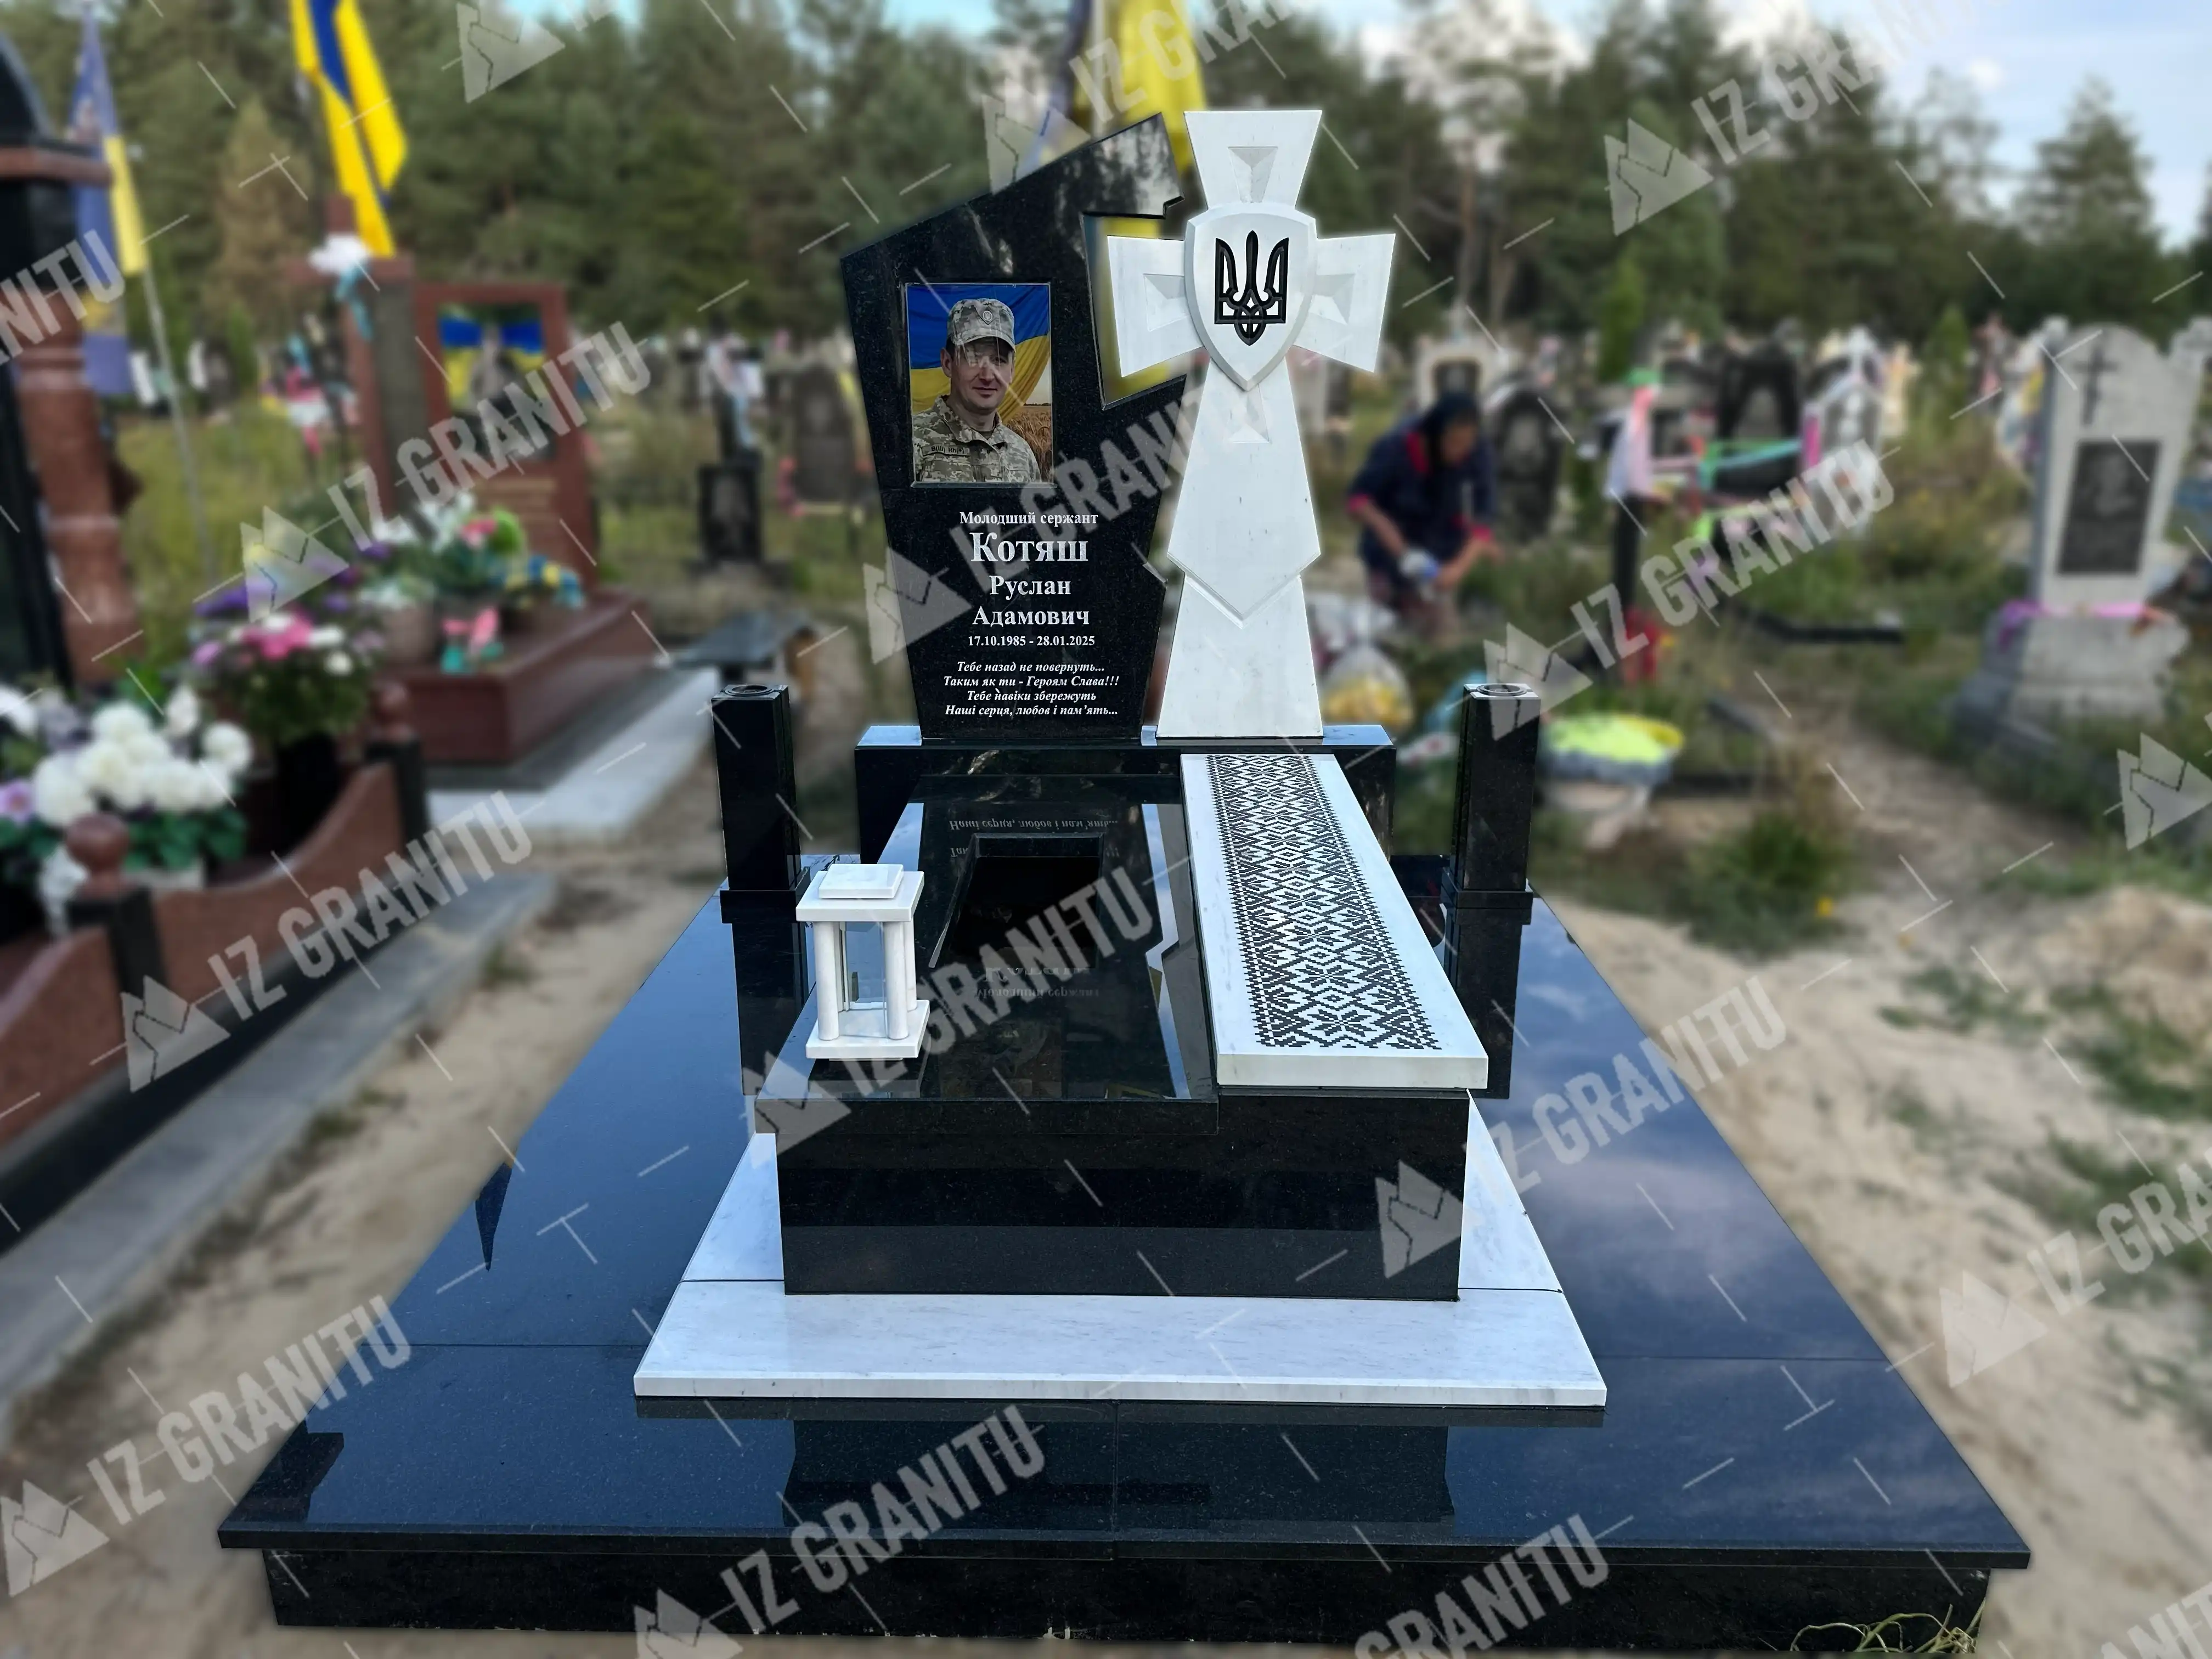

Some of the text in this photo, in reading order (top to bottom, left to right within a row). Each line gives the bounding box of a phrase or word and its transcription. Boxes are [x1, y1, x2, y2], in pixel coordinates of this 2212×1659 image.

[960, 511, 1098, 527] Молодший сержант
[969, 532, 1088, 562] Котяш
[989, 575, 1071, 600] Руслан
[972, 606, 1090, 627] Адамович
[968, 636, 1026, 646] 17.10.1985
[1037, 636, 1095, 646] 28.01.2025
[957, 661, 982, 672] Тебе
[985, 661, 1017, 672] назад
[1035, 664, 1104, 674] повернуть...
[944, 676, 979, 686] Таким
[1026, 676, 1067, 689] Героям
[1071, 676, 1119, 686] Слава!!!
[967, 690, 1096, 703] Тебе навіки збережуть
[945, 705, 976, 715] Наші
[978, 708, 1013, 718] серця,
[1015, 705, 1050, 715] любов
[1053, 705, 1058, 715] і
